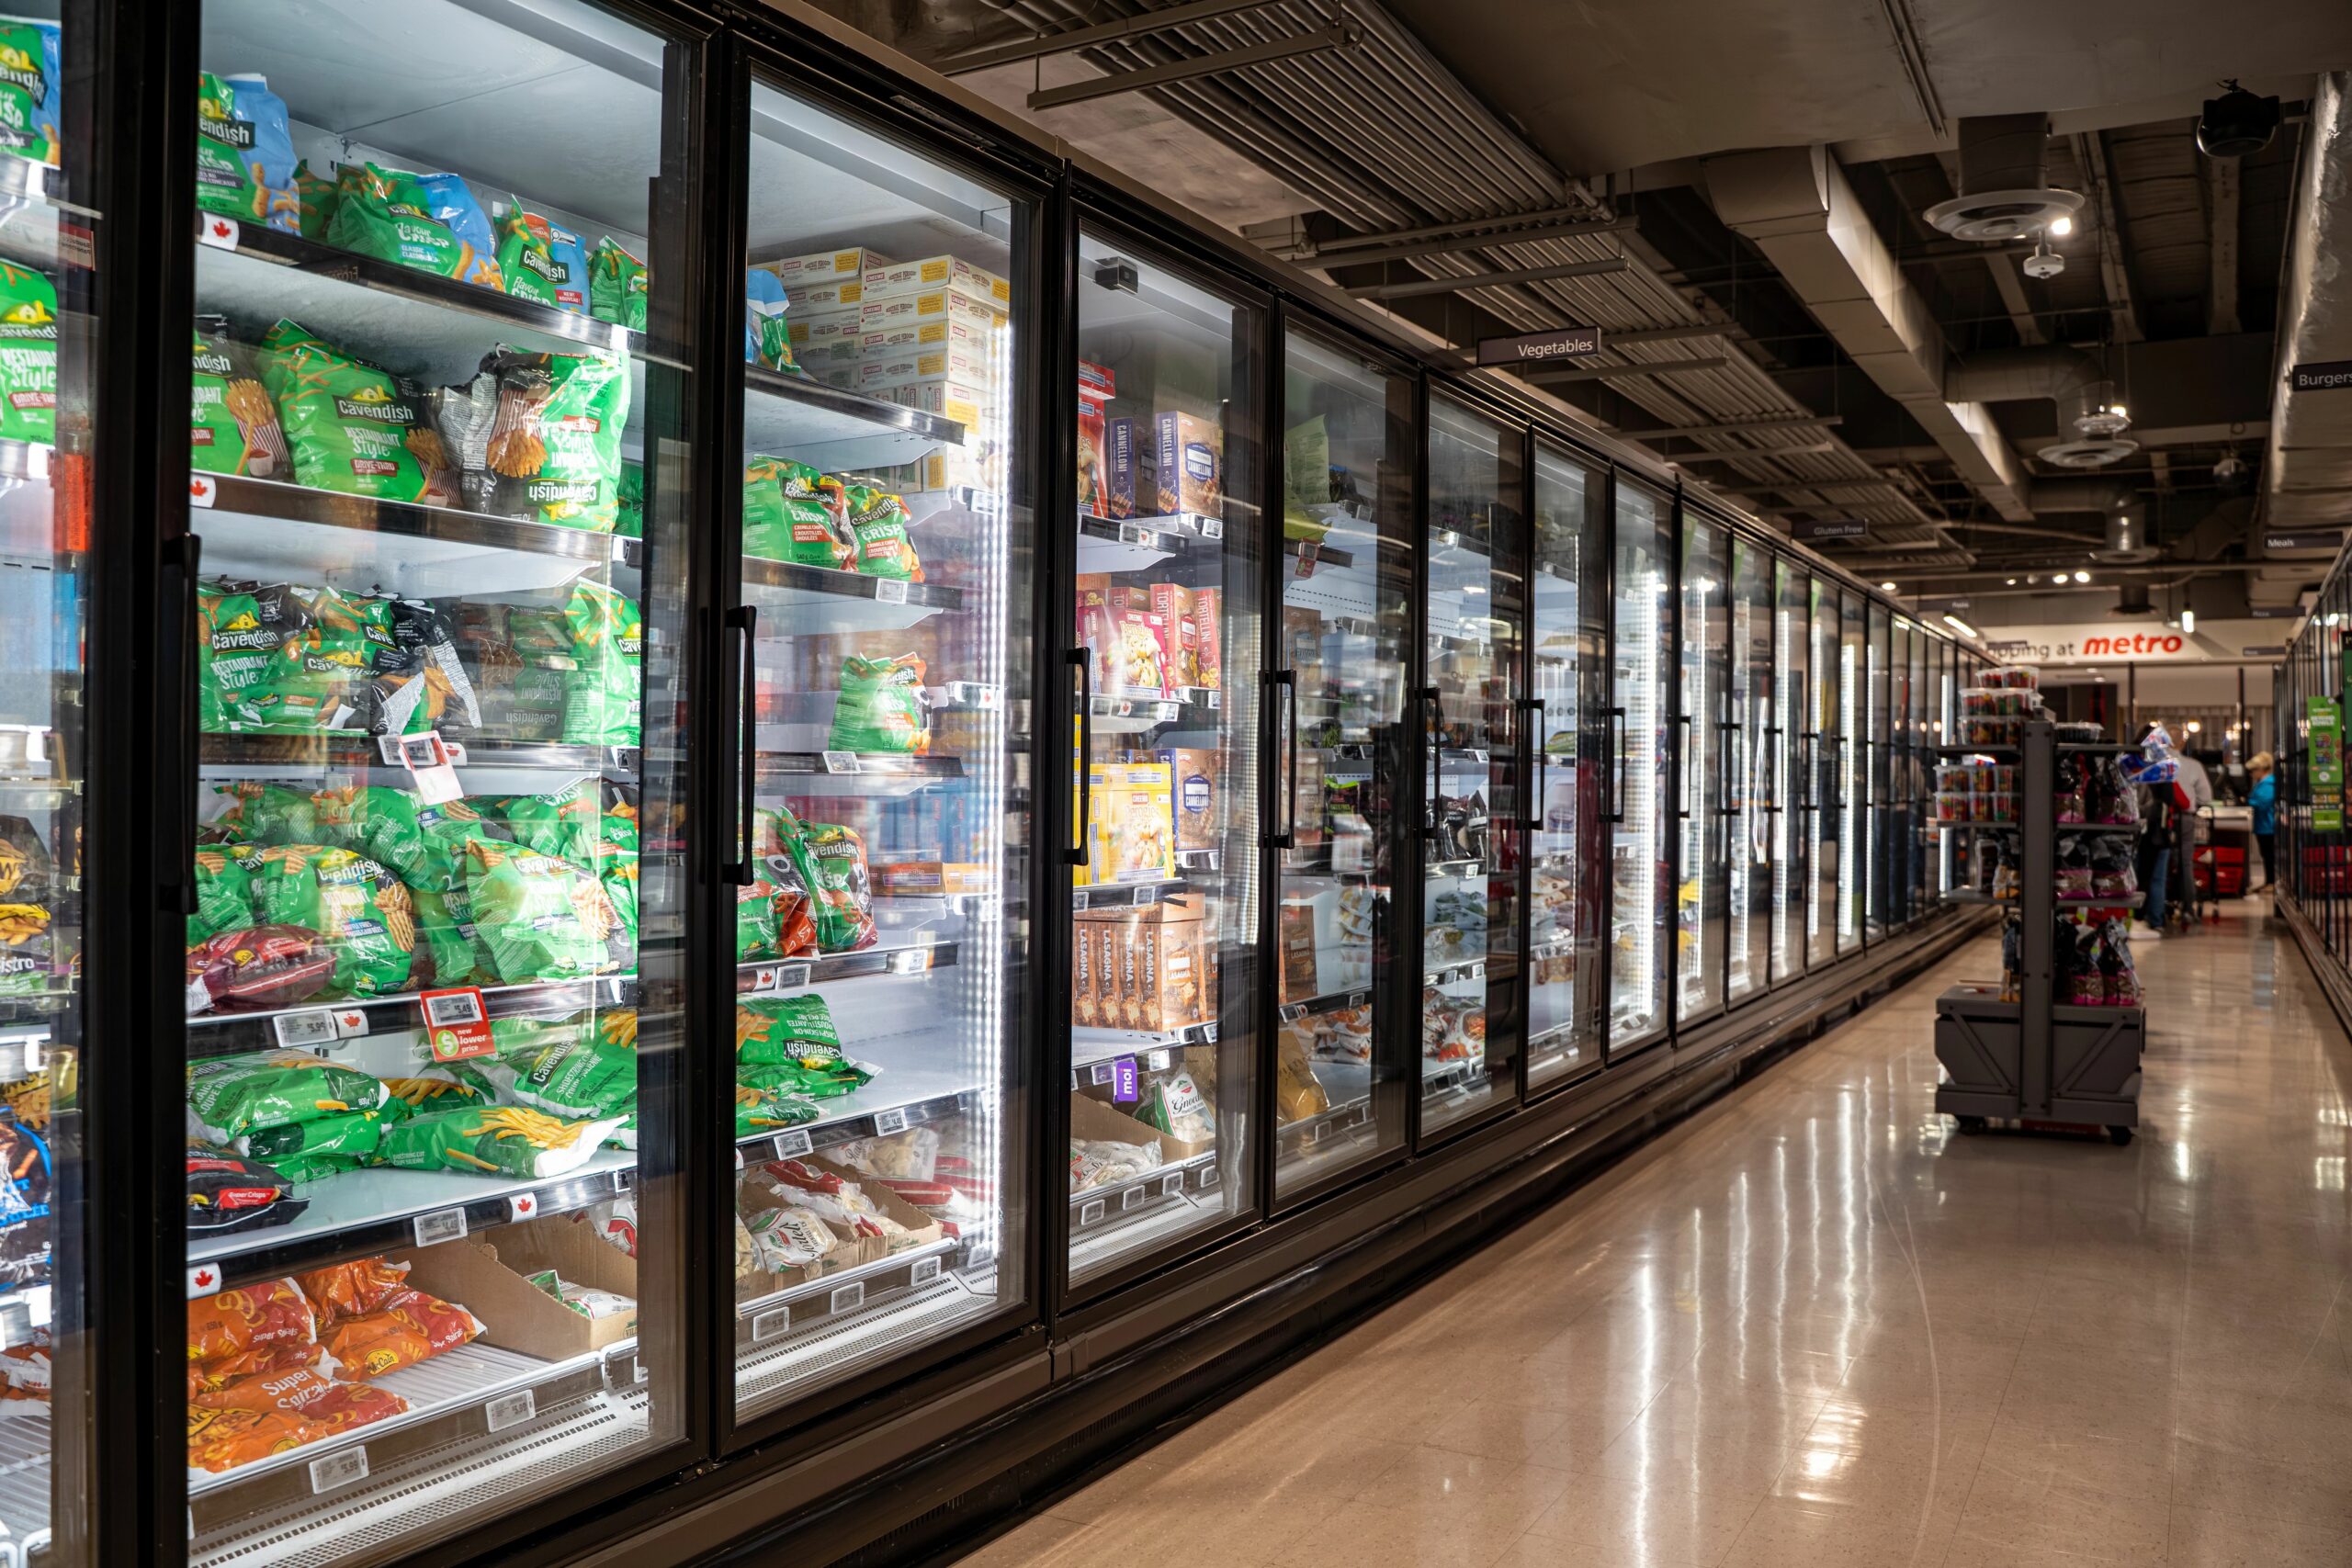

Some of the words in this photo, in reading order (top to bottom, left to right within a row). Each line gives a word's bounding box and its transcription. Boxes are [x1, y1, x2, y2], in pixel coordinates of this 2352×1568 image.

[199, 118, 250, 144] endish
[523, 252, 566, 280] Cavendish
[1, 348, 57, 367] RESTAUR
[1518, 338, 1593, 359] Vegetables
[194, 355, 232, 372] ndish
[2299, 371, 2352, 387] Burgers
[338, 400, 414, 421] Cavendish
[345, 426, 401, 448] RESTAURANT
[1162, 418, 1171, 467] CANNELLONI
[353, 439, 392, 459] Style
[1117, 424, 1126, 472] CANNELLONI
[528, 483, 598, 502] Cavendish
[862, 523, 902, 542] CRISP
[1815, 526, 1843, 536] Gluten
[2268, 538, 2294, 547] Meals
[1197, 595, 1212, 643] TORTELLINI
[211, 628, 279, 650] Cavendish
[2056, 642, 2075, 657] at
[2083, 633, 2183, 655] metro
[210, 654, 270, 677] RESTAURANT
[220, 671, 260, 691] Style
[506, 711, 558, 726] Cavendish
[442, 891, 470, 909] RESTA
[450, 906, 471, 920] Sty
[1080, 929, 1088, 979] LASAGNA
[1103, 930, 1112, 981] LASAGNA
[1146, 931, 1154, 983] LASAGNA
[0, 957, 35, 973] istro
[1170, 969, 1191, 979] LASAGNA
[459, 1033, 487, 1045] lower
[461, 1044, 480, 1055] price
[533, 1033, 575, 1083] Cavendish
[786, 1042, 842, 1058] Cavendish
[1123, 1068, 1132, 1095] moi
[253, 1331, 275, 1344] Super
[368, 1354, 395, 1374] McCain
[261, 1369, 312, 1396] Super
